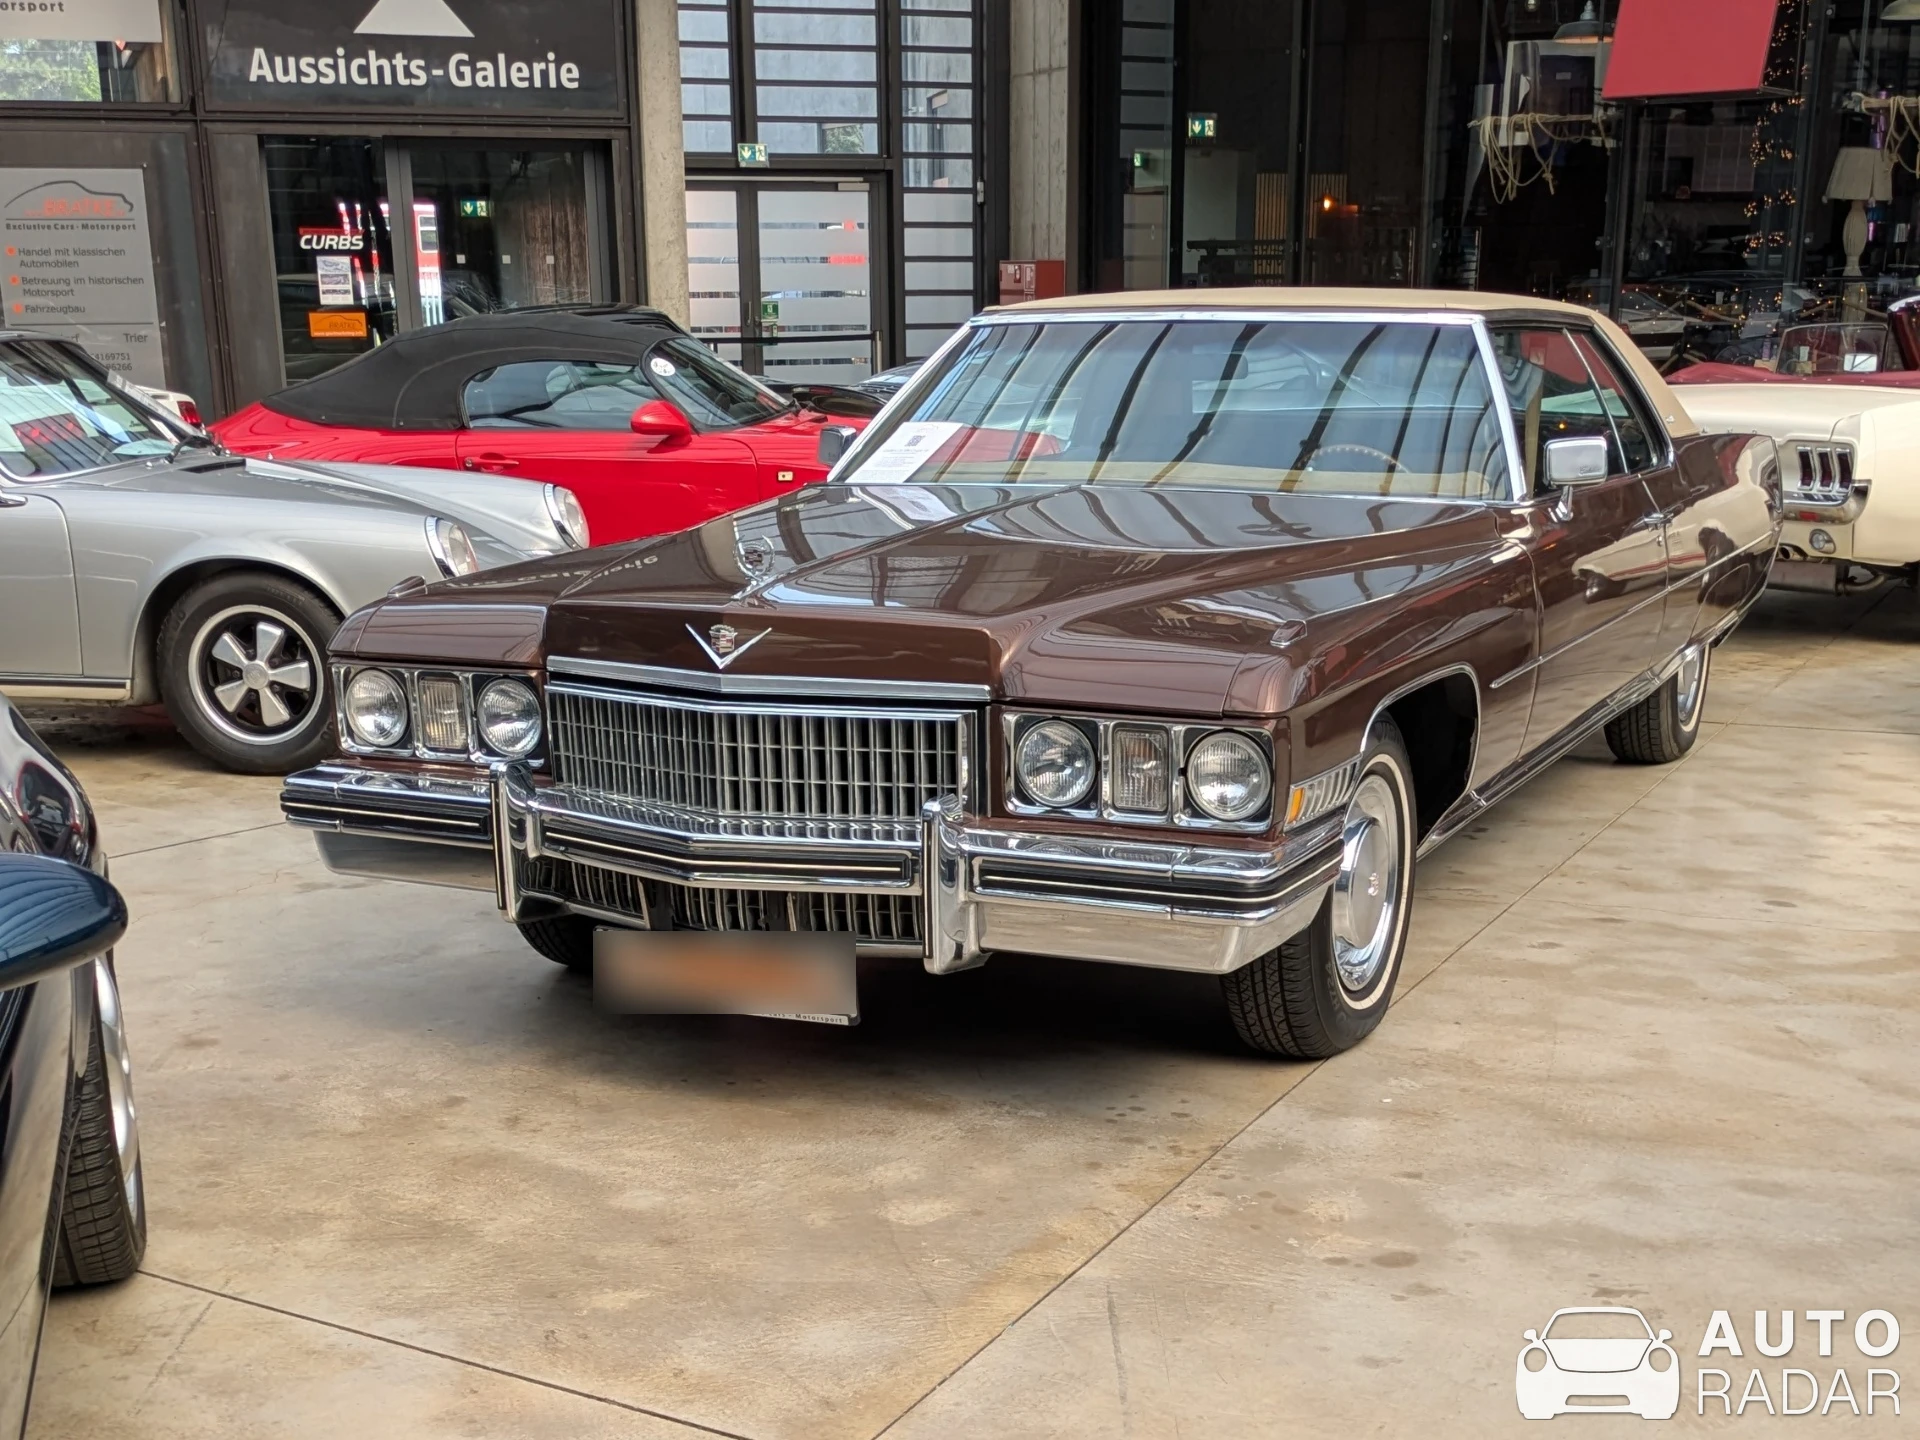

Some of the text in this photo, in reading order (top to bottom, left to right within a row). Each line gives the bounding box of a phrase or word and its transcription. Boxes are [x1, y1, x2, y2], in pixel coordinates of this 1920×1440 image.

[249, 47, 580, 89] Aussichts-Galerie
[81, 223, 136, 231] Motorsport
[300, 234, 364, 250] CURBS
[18, 248, 126, 256] Handel mit klassischen
[20, 260, 79, 268] Automobilen
[22, 276, 144, 286] Betreuung im historischen
[23, 289, 75, 297] Motorsport
[25, 305, 86, 314] Fahrzeugbau
[123, 333, 149, 343] Trier
